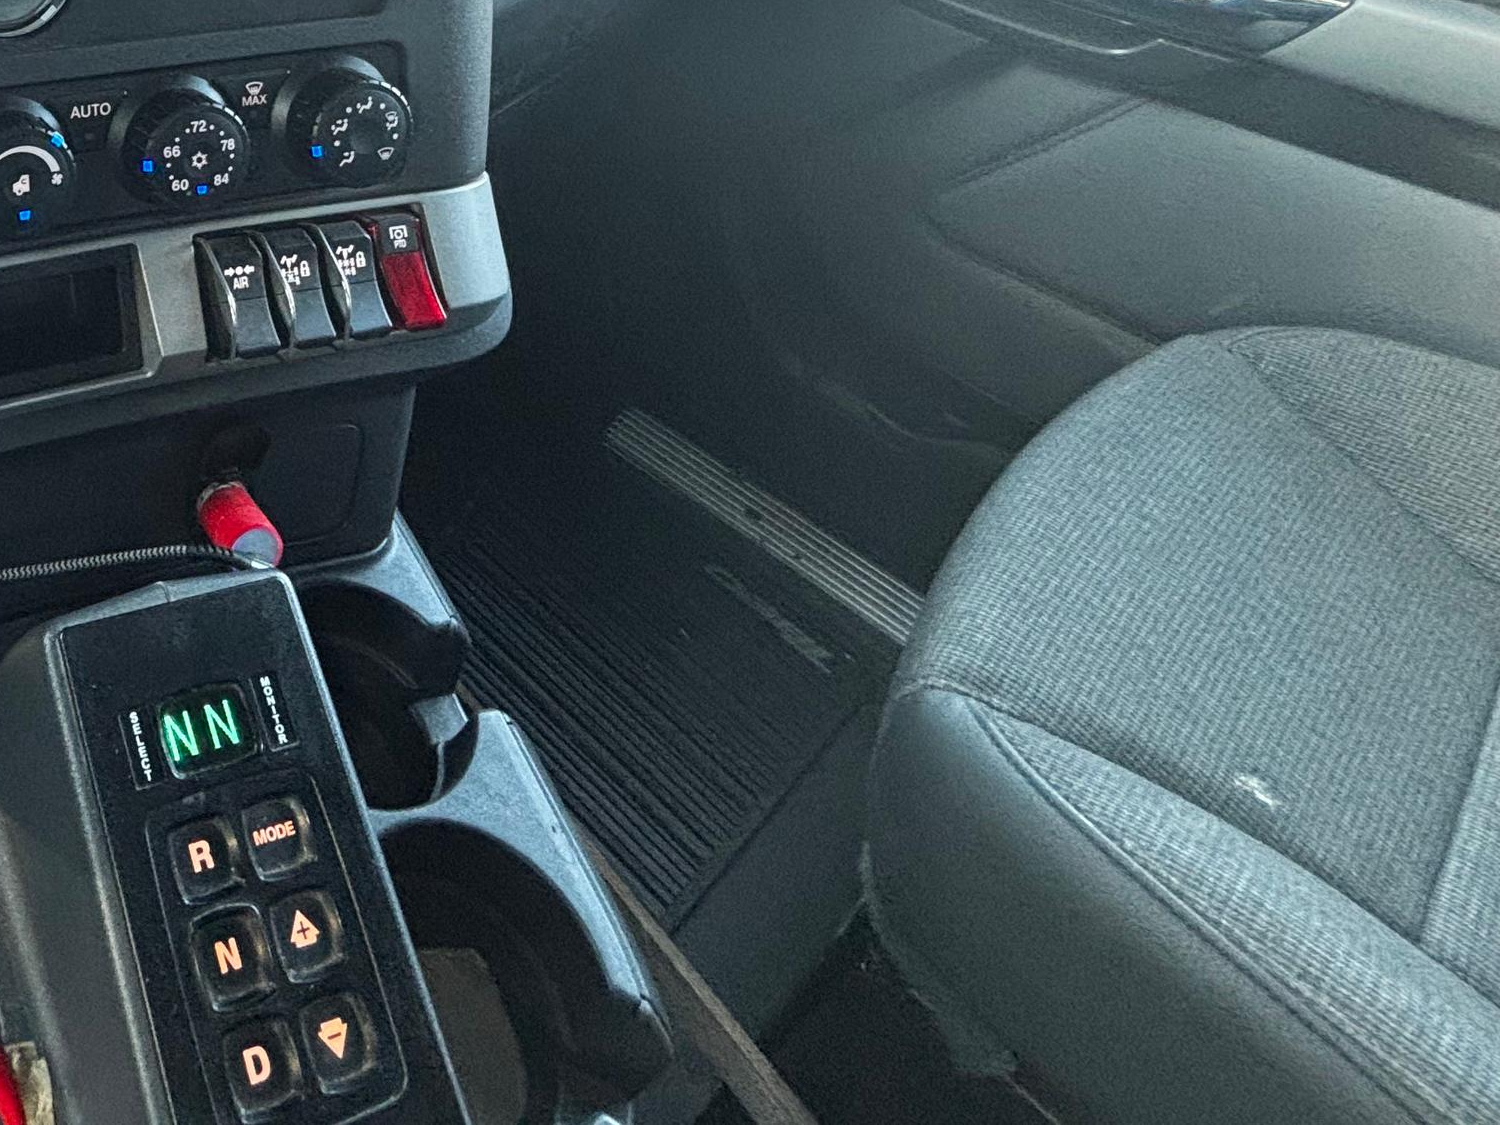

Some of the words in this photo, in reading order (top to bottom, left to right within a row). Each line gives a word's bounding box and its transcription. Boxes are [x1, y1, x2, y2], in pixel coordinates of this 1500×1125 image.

[241, 93, 268, 107] MAX
[70, 102, 112, 120] AUTO
[190, 120, 208, 133] 72
[163, 145, 181, 159] 66
[220, 138, 236, 152] 78
[171, 179, 189, 192] 60
[213, 173, 230, 186] 84
[233, 275, 250, 290] AIR
[259, 675, 289, 745] MONITOR
[129, 711, 152, 782] SELECT
[252, 820, 296, 847] MODE
[187, 839, 215, 874] R
[214, 936, 243, 975] N
[242, 1045, 272, 1085] D
